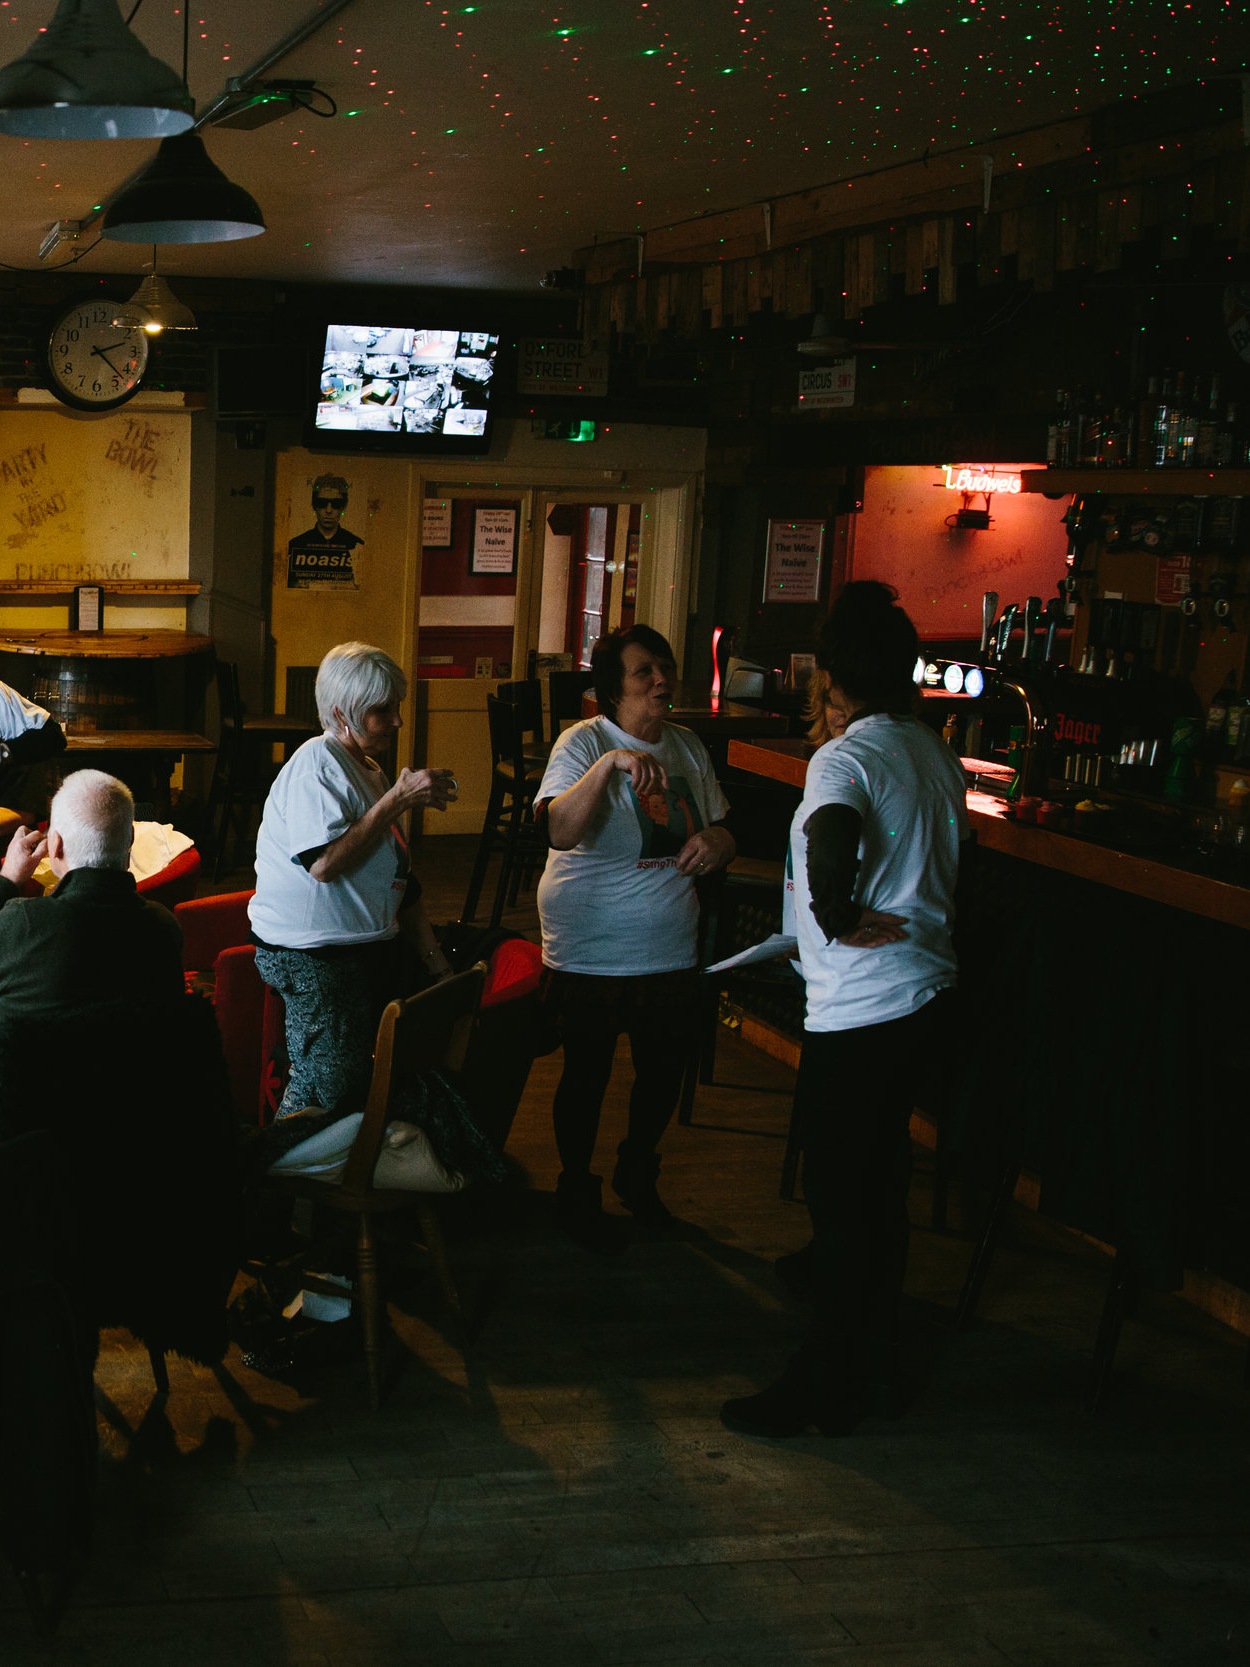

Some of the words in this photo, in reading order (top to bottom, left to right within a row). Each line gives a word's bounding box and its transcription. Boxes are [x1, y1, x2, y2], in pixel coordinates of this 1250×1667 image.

[79, 316, 89, 329] 11
[93, 311, 107, 323] 12
[66, 329, 79, 342] 10
[123, 328, 131, 339] 2
[59, 344, 69, 357] 9
[130, 346, 137, 358] 3
[63, 362, 73, 375] 8
[122, 363, 131, 374] 4
[524, 361, 582, 378] STREET
[78, 375, 86, 387] 7
[111, 375, 119, 387] 5
[802, 368, 832, 385] CIRCUS
[92, 380, 101, 392] 6
[123, 417, 160, 452] THE
[480, 525, 493, 533] The
[494, 525, 512, 533] Wise
[775, 543, 791, 552] The
[793, 543, 815, 553] Wise
[295, 552, 353, 567] noasis
